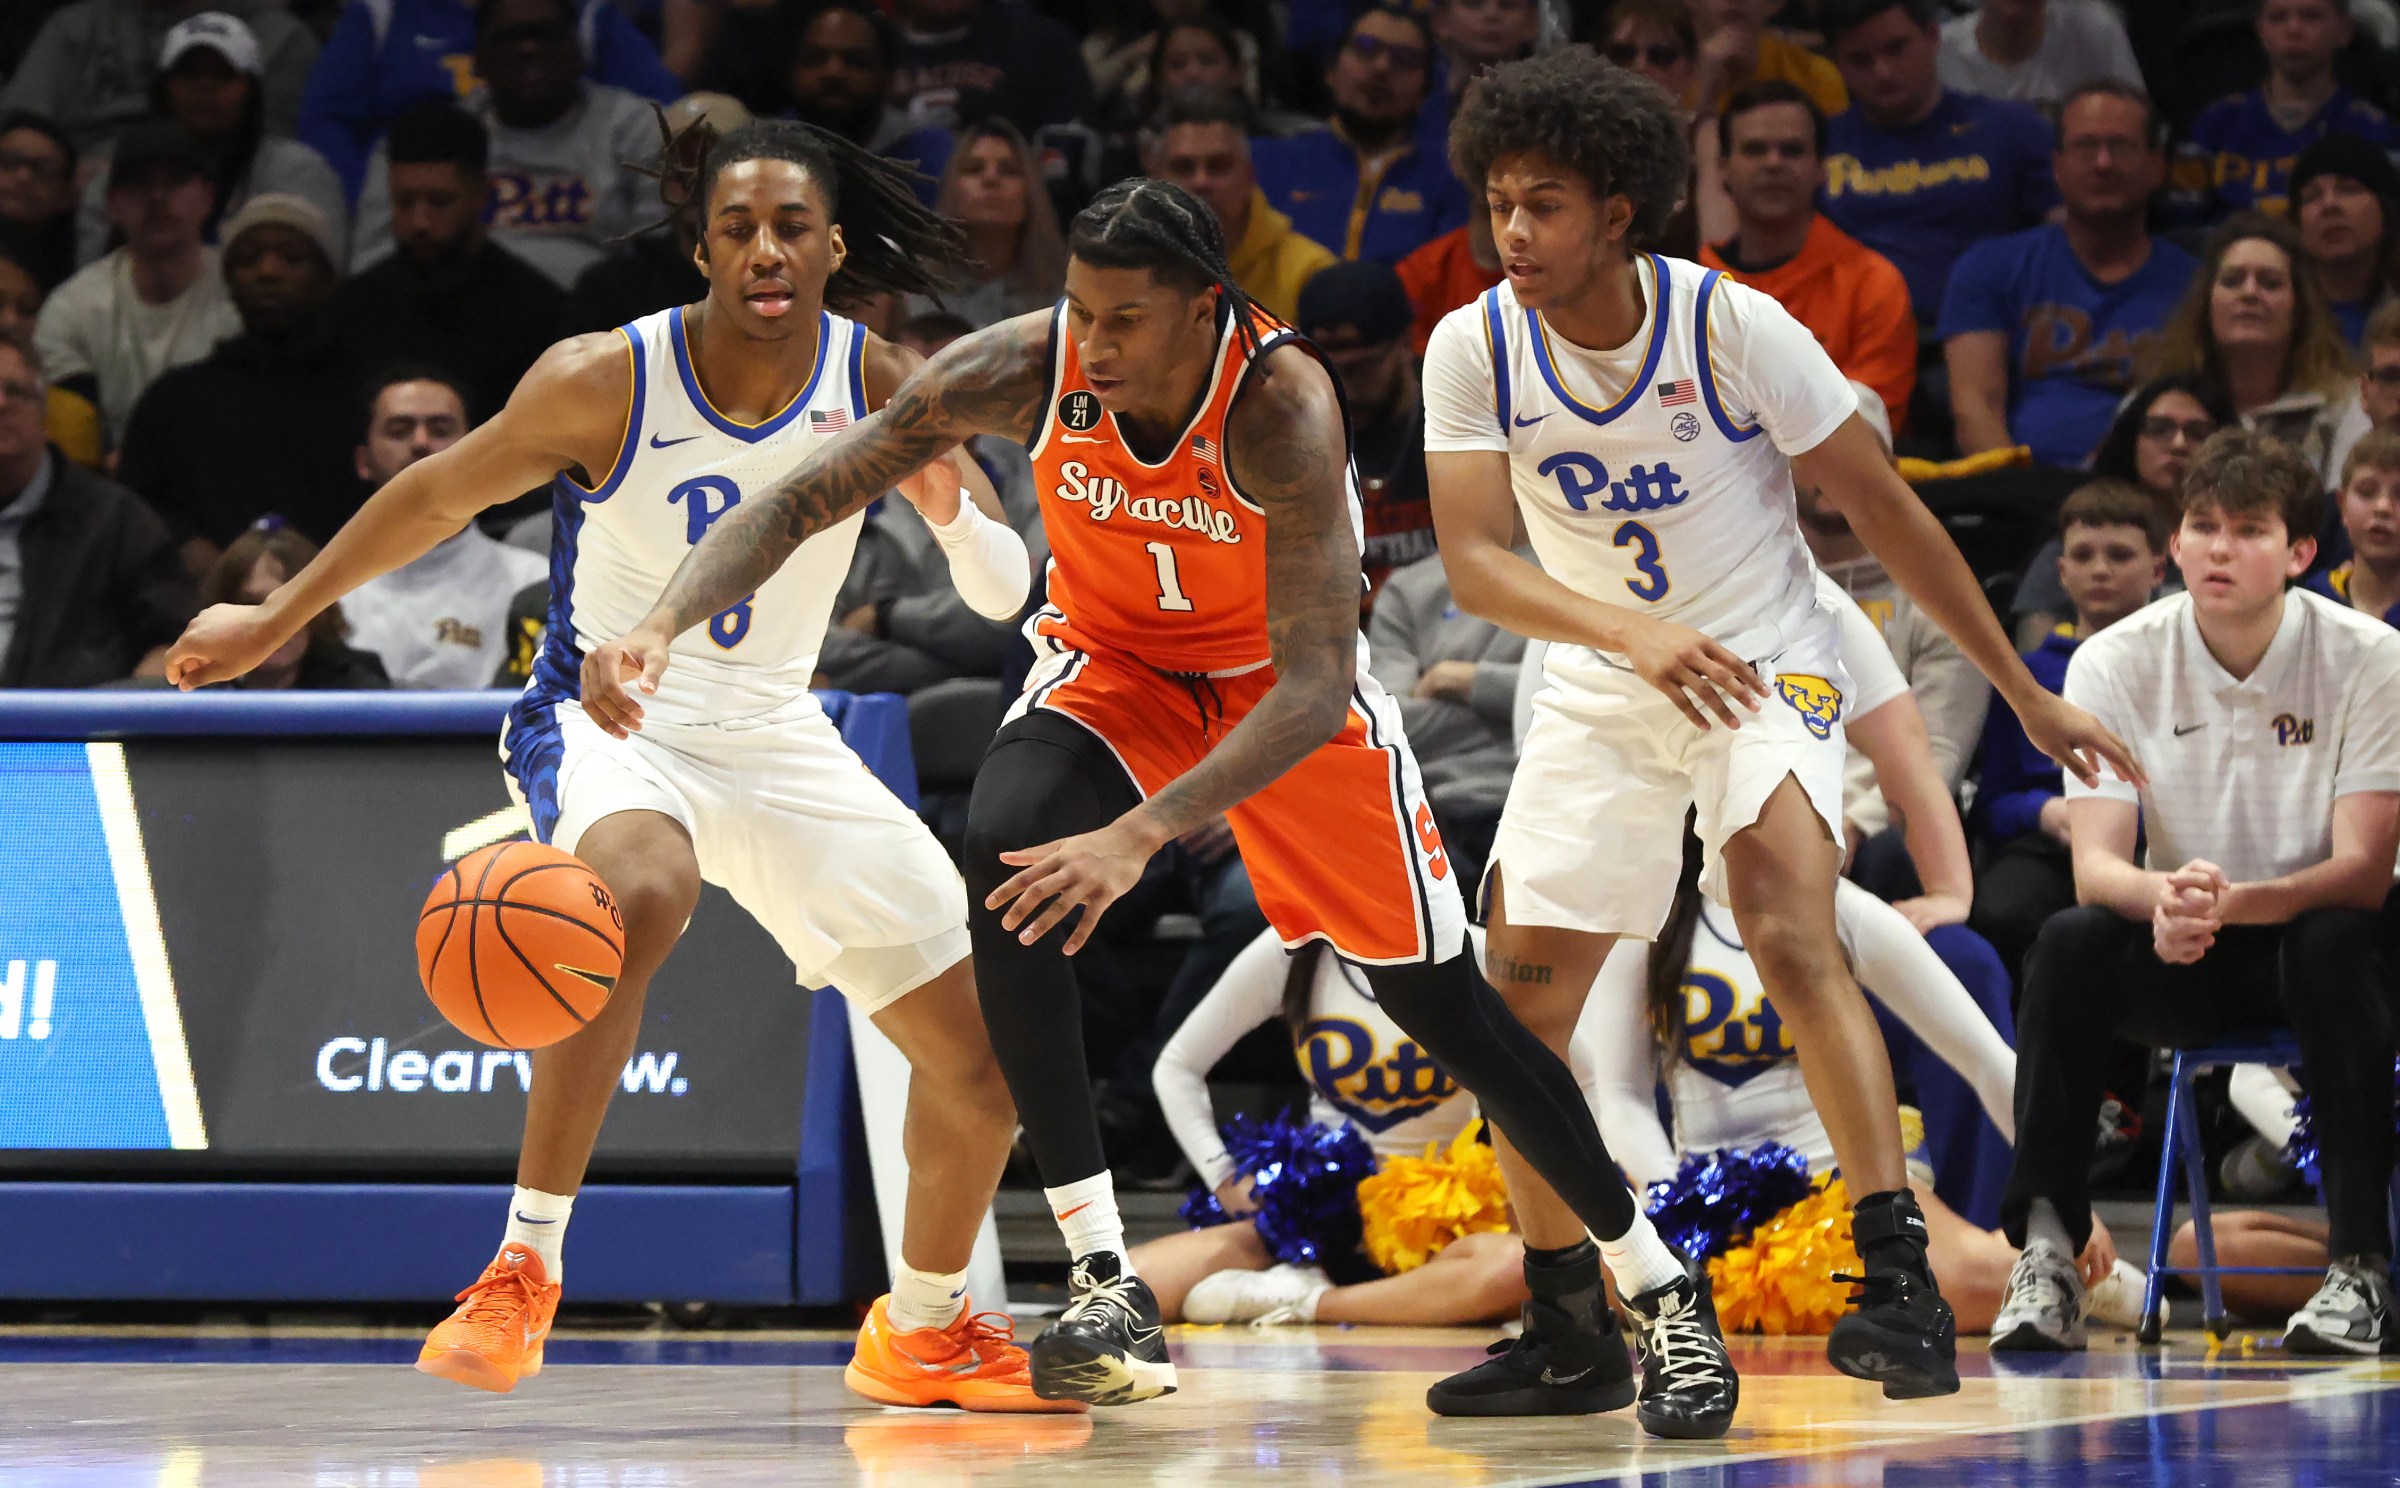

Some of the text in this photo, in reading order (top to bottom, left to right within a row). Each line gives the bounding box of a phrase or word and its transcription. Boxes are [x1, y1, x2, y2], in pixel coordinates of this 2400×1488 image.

[1071, 410, 1087, 427] 21
[1073, 395, 1087, 408] LM
[1056, 461, 1241, 544] Syracuse
[1537, 451, 1690, 512] Pitt
[1145, 541, 1195, 612] 1
[1611, 520, 1672, 604] 3
[1415, 801, 1448, 881] S
